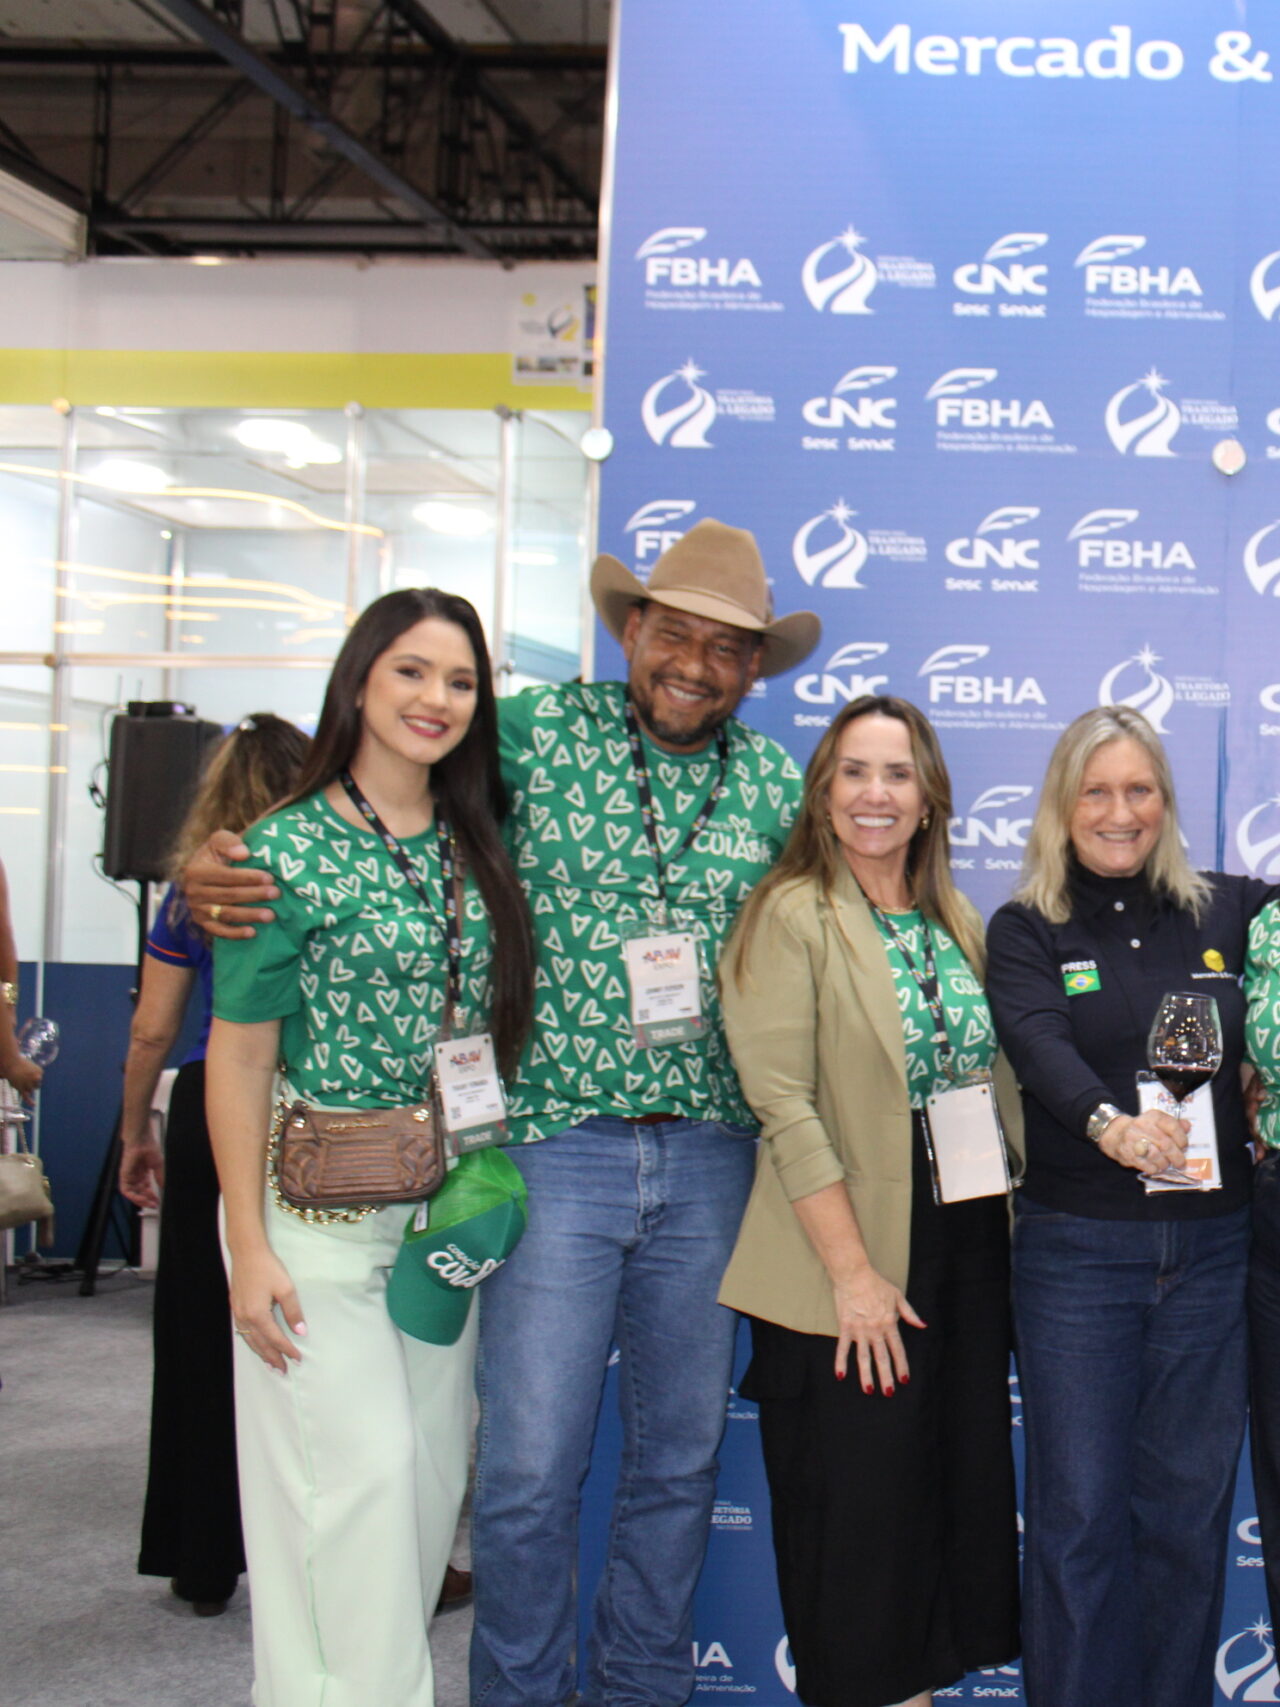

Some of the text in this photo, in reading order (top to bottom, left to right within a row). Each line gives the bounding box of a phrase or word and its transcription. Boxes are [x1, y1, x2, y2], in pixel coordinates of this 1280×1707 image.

[838, 23, 1184, 80] Mercado
[1208, 31, 1273, 83] &
[646, 256, 762, 287] FBHA
[954, 264, 1047, 294] CNC
[1085, 264, 1203, 296] FBHA
[803, 398, 896, 427] CNC
[936, 397, 1054, 428] FBHA
[946, 538, 1039, 568] CNC
[1078, 539, 1196, 570] FBHA
[946, 578, 1038, 591] Sesc Senac
[794, 674, 888, 704] CNC
[929, 675, 1047, 705] FBHA
[794, 713, 830, 726] Sesc
[1061, 960, 1098, 974] PRESS
[650, 1026, 685, 1042] TRADE
[463, 1130, 493, 1146] TRADE
[711, 1515, 752, 1525] EGADO
[1236, 1555, 1266, 1567] Ses
[696, 1684, 757, 1694] Alimentação
[719, 1674, 734, 1682] de
[973, 1686, 1019, 1698] Senac
